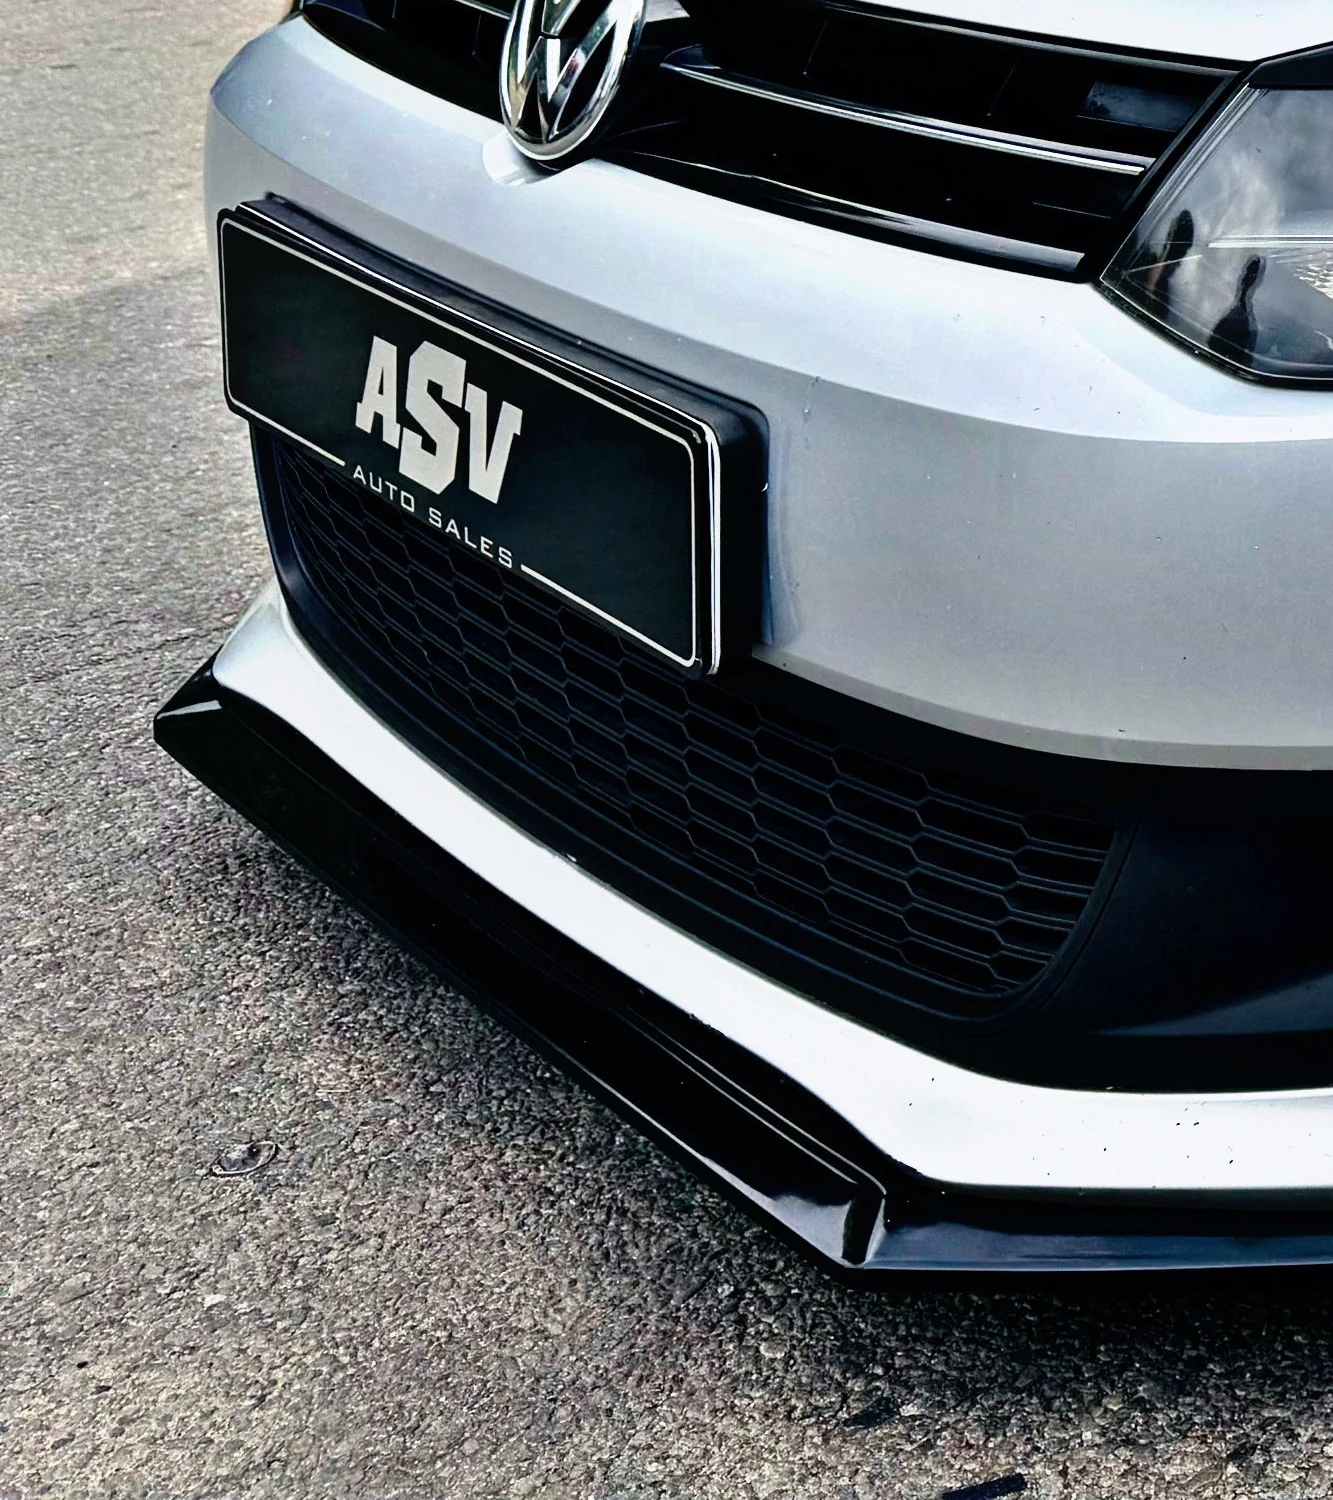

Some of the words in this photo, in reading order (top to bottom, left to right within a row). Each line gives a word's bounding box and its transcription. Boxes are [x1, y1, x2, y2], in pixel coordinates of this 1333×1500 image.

[355, 335, 523, 504] ASV
[353, 465, 415, 513] AUTO
[428, 506, 512, 568] SALES
